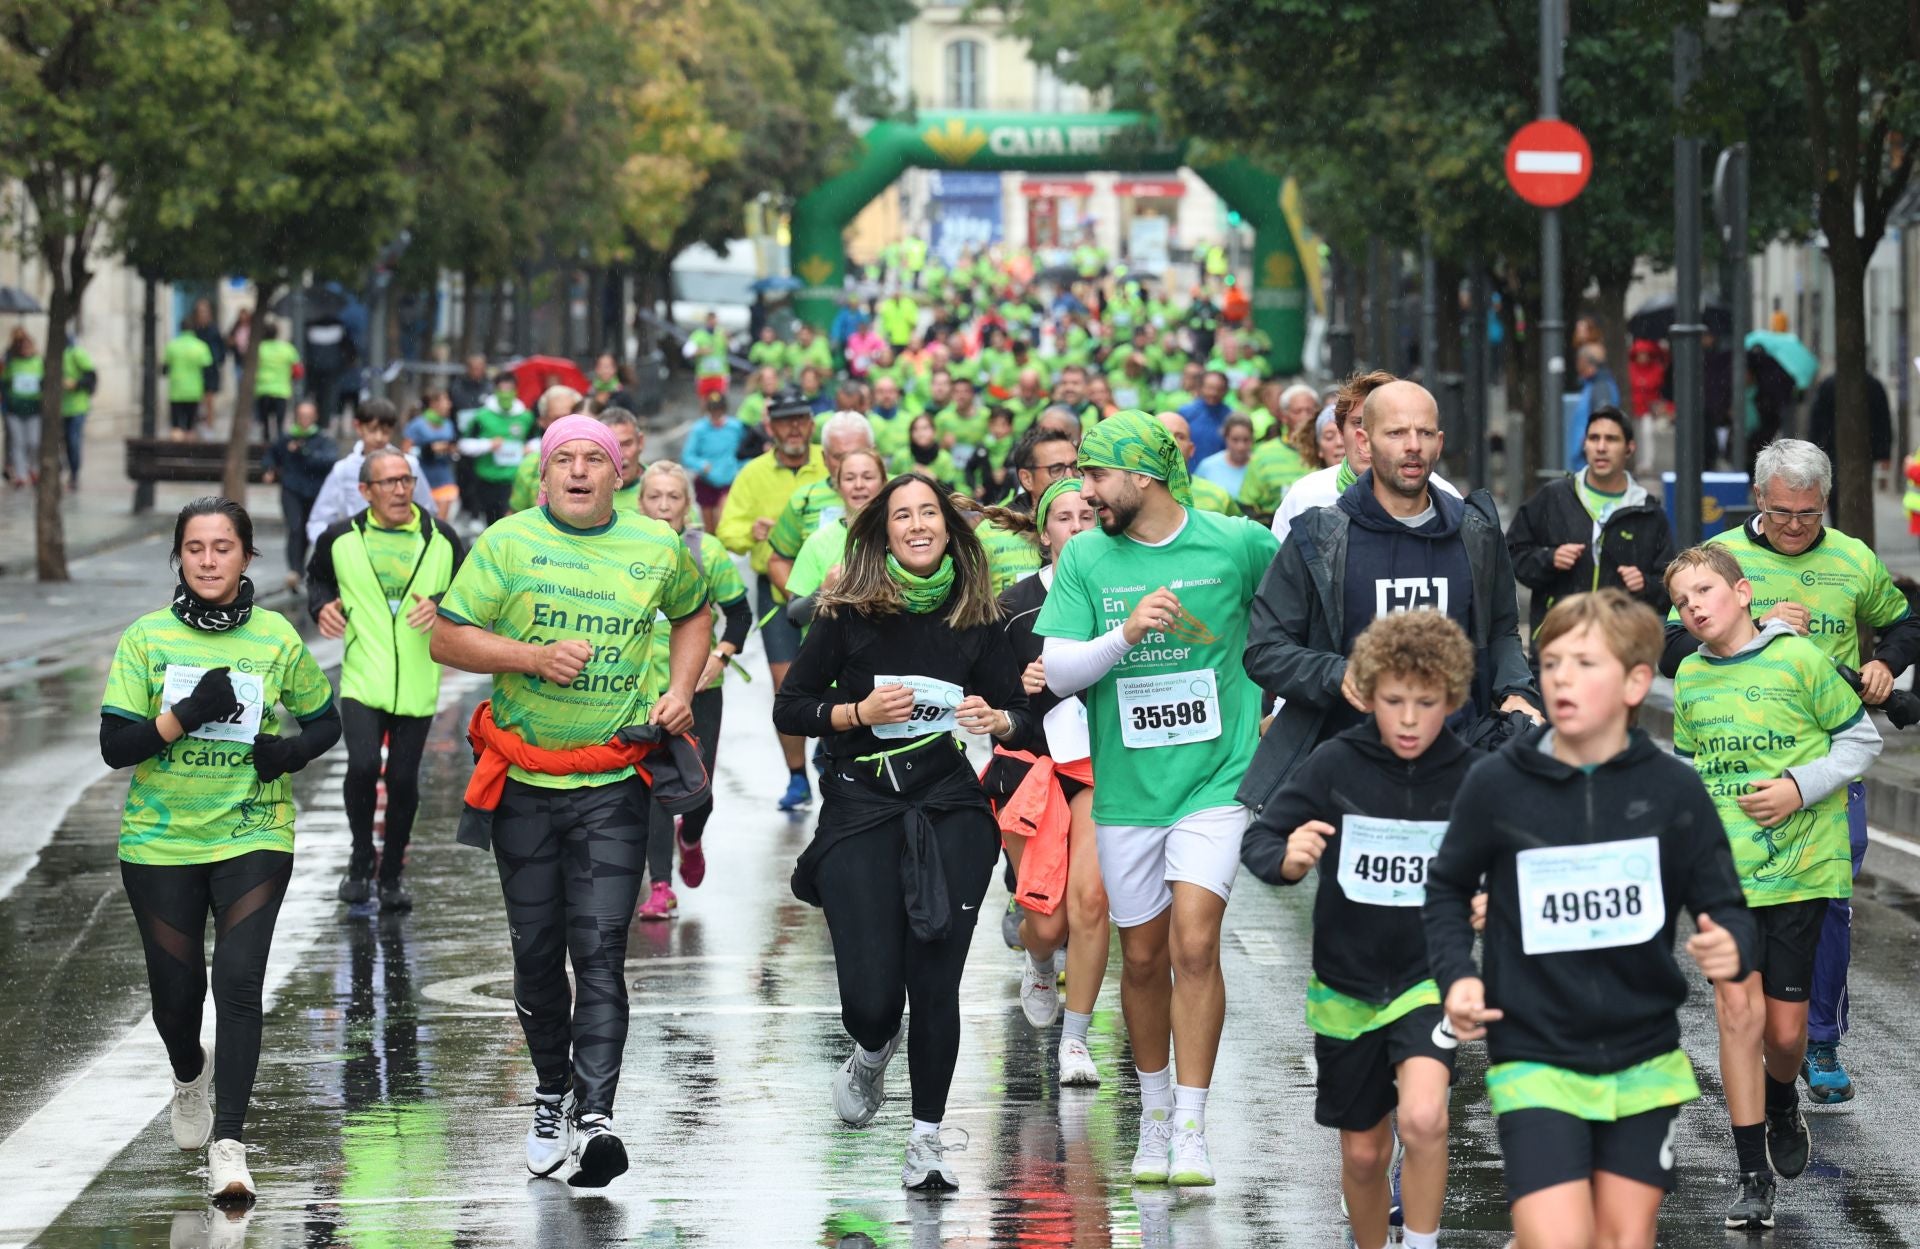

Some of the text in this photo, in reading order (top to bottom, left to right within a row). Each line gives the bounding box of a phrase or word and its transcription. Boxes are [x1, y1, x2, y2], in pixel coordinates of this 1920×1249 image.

[536, 583, 616, 601] XIII Valladolid
[1110, 584, 1146, 593] Valladolid
[532, 603, 568, 629] En
[1103, 598, 1125, 613] En
[1808, 614, 1846, 635] cha
[1129, 647, 1191, 665] cáncer
[910, 704, 951, 722] 597
[1132, 699, 1207, 730] 35598
[1709, 730, 1796, 753] marcha
[182, 746, 254, 767] cánce
[1355, 854, 1436, 884] 4963
[1542, 885, 1642, 924] 49638
